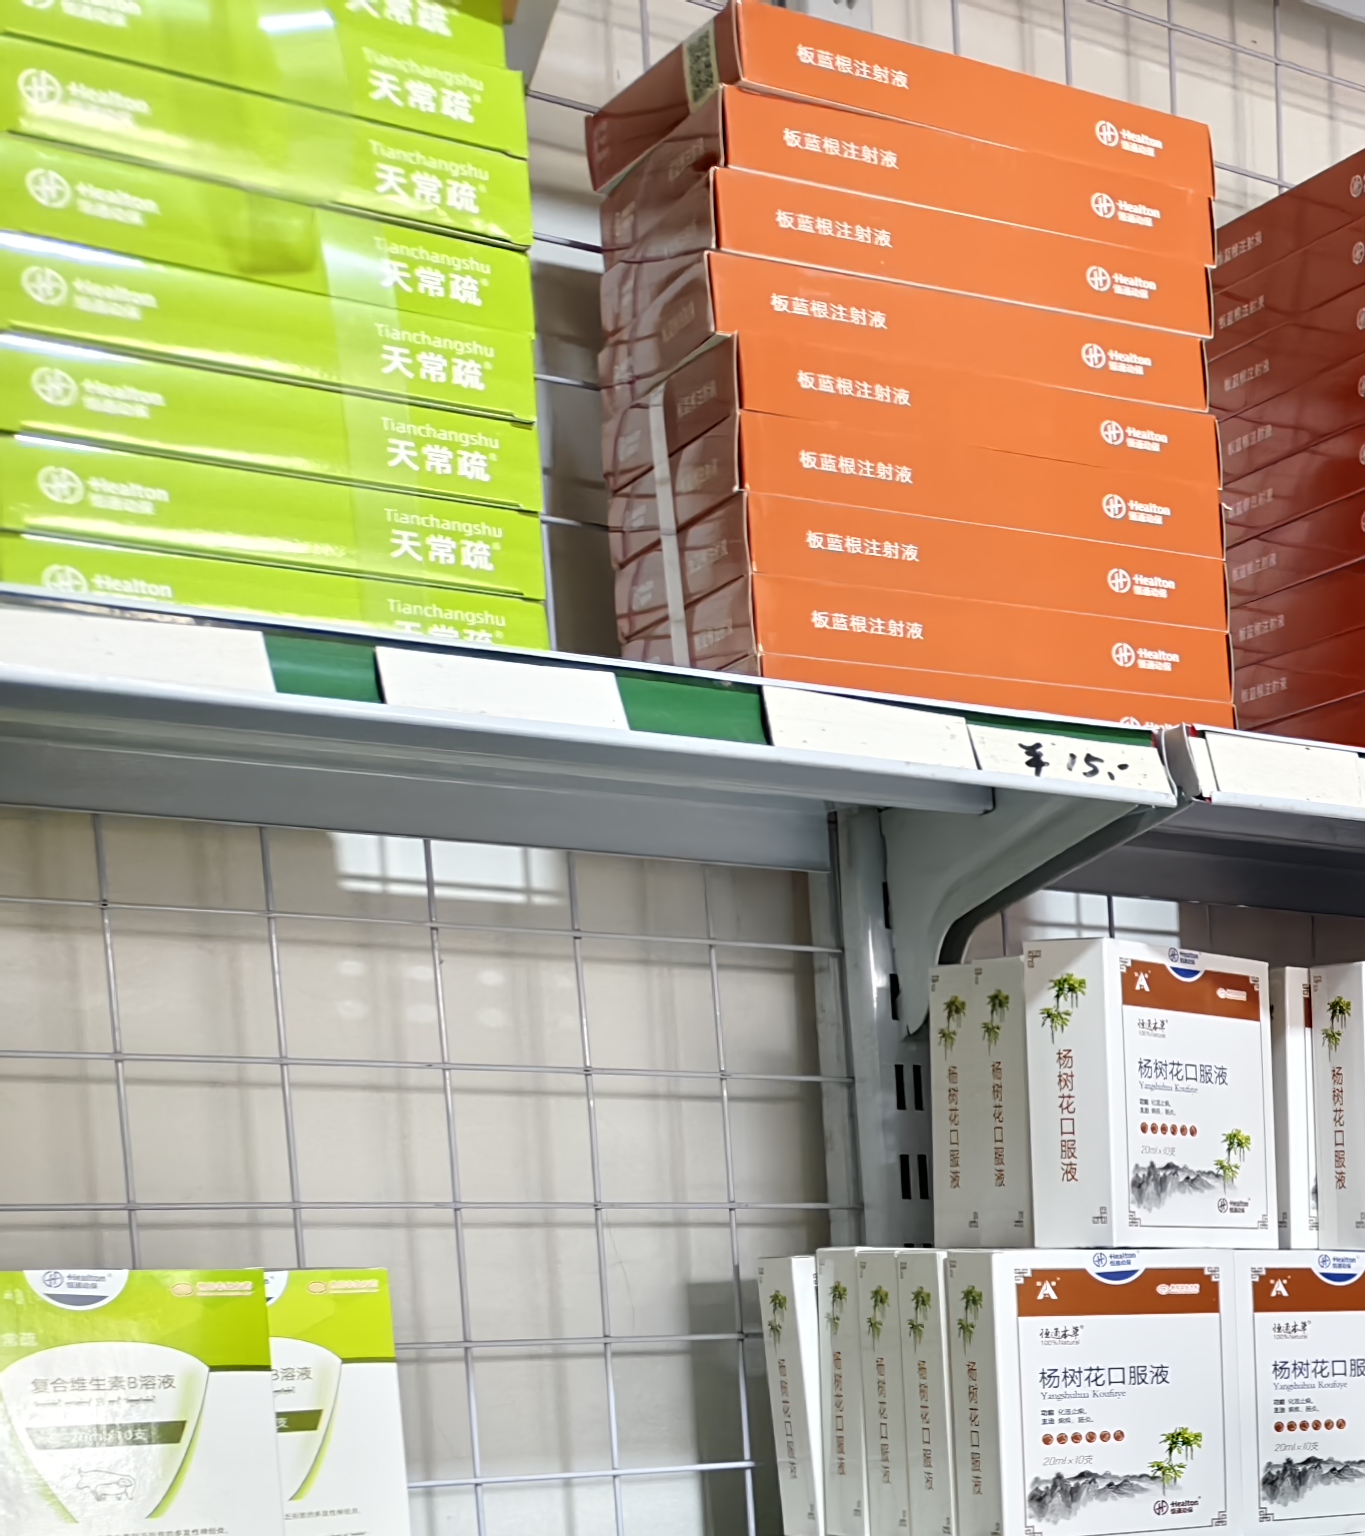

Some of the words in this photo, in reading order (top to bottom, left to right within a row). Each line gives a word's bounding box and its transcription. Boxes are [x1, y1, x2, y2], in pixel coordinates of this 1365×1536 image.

[361, 47, 484, 91] Tianchangshu
[796, 43, 910, 89] 板蓝根注射液
[782, 128, 900, 169] 板蓝根注射液
[1119, 128, 1164, 150] Healton
[368, 139, 489, 181] Tianchangshu
[1115, 200, 1162, 220] Healton
[774, 209, 893, 248] 板蓝根注射液
[374, 236, 491, 275] Tianchangshu
[1112, 272, 1157, 292] Healton
[770, 292, 888, 330] 板蓝根注射液
[374, 323, 494, 359] Tianchangshu
[1106, 349, 1153, 368] Healton
[796, 371, 912, 406] 板蓝根注射液
[380, 416, 499, 451] Tianchangshu
[1124, 426, 1169, 445] Healton
[798, 450, 914, 485] 板蓝根注射液
[384, 507, 503, 538] Tianchangshu
[1127, 500, 1172, 518] Healton
[805, 530, 920, 562] 板蓝根注射液
[1131, 574, 1176, 592] Healton
[387, 598, 506, 628] Tianchangshu
[810, 610, 925, 640] 板蓝根注射液
[1136, 647, 1180, 665] Healton
[1138, 1057, 1229, 1087] 杨树花口服液
[1056, 1048, 1078, 1182] 杨树花口服液
[31, 1374, 176, 1395] 复合维生素B溶液
[1039, 1364, 1170, 1389] 杨树花口服液
[1171, 1499, 1199, 1508] Healton
